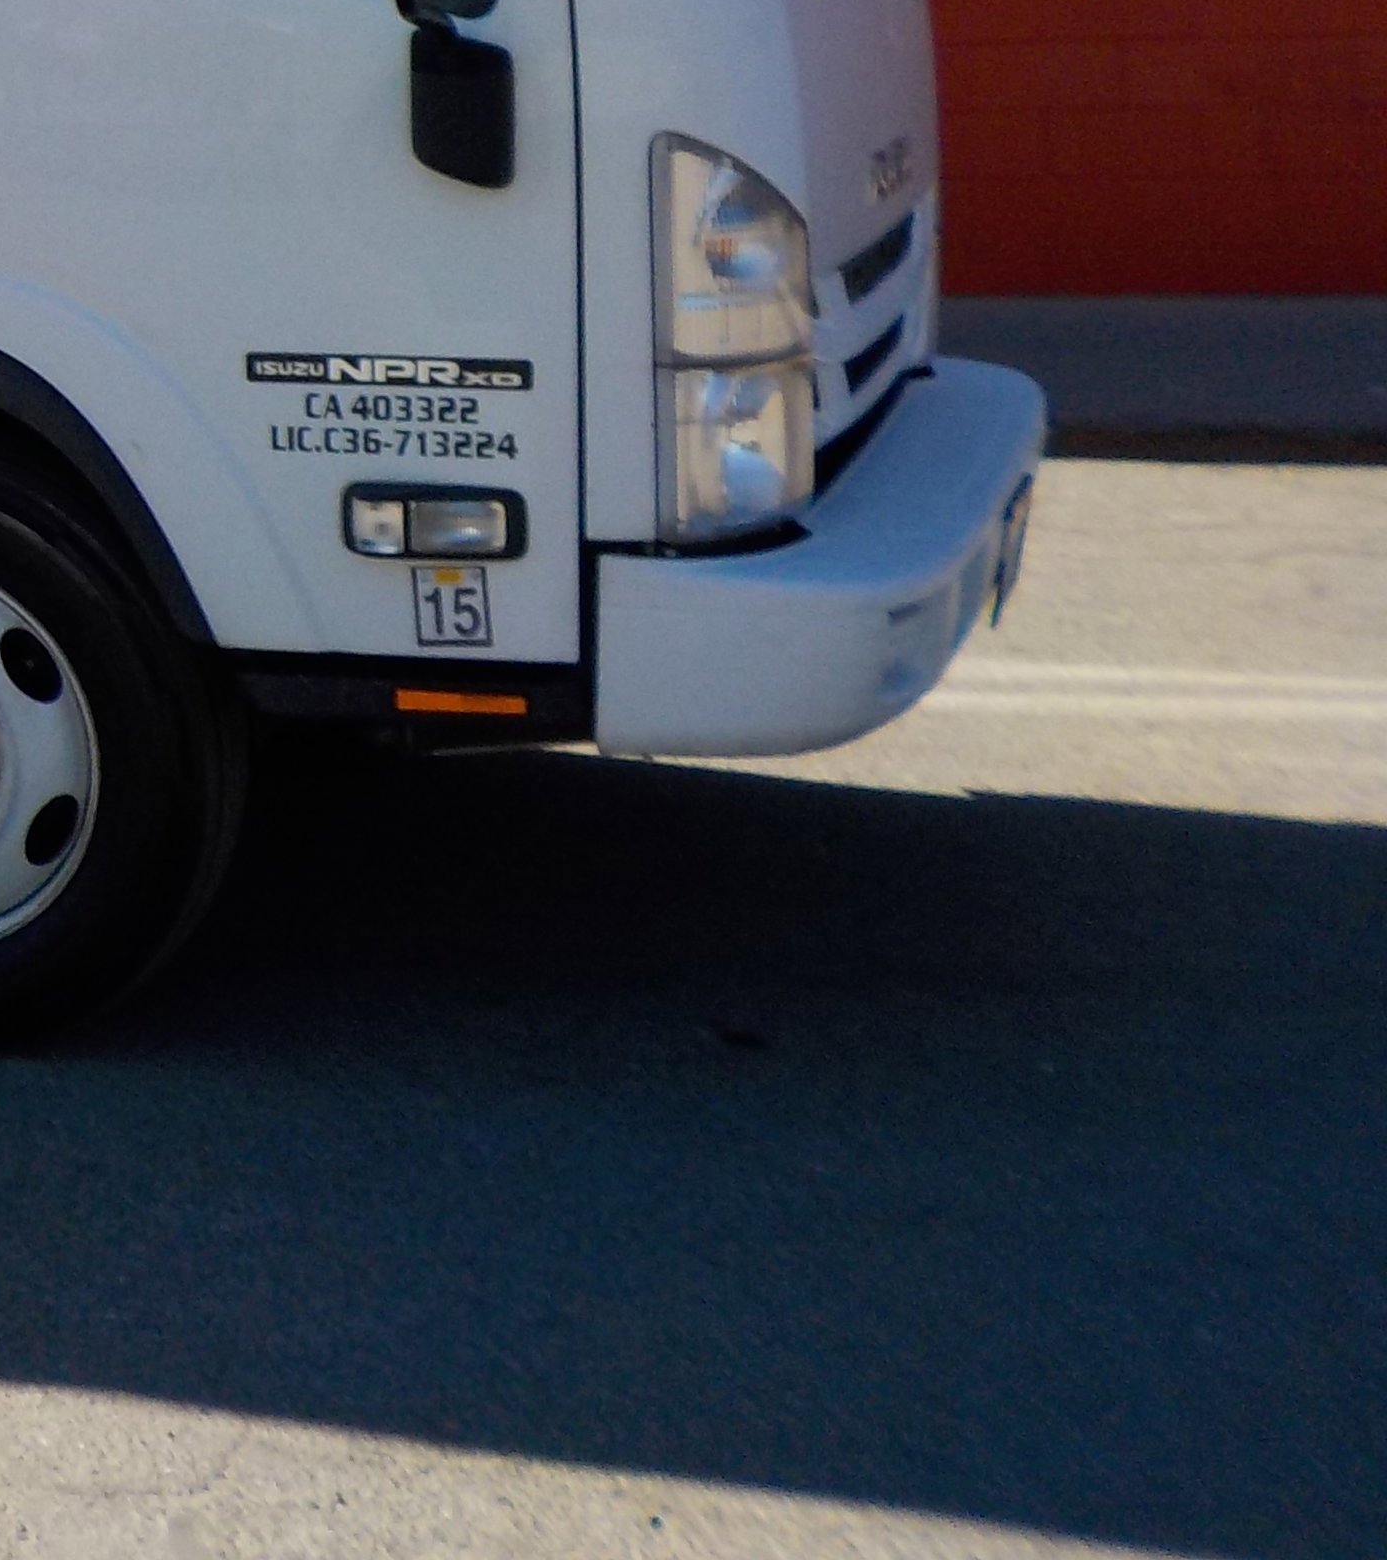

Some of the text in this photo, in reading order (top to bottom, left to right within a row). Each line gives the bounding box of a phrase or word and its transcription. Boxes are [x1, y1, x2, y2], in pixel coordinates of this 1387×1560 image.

[255, 360, 325, 378] ISUZU
[328, 357, 460, 386] NPR
[304, 392, 480, 425] CA 403322
[424, 586, 482, 636] 15
